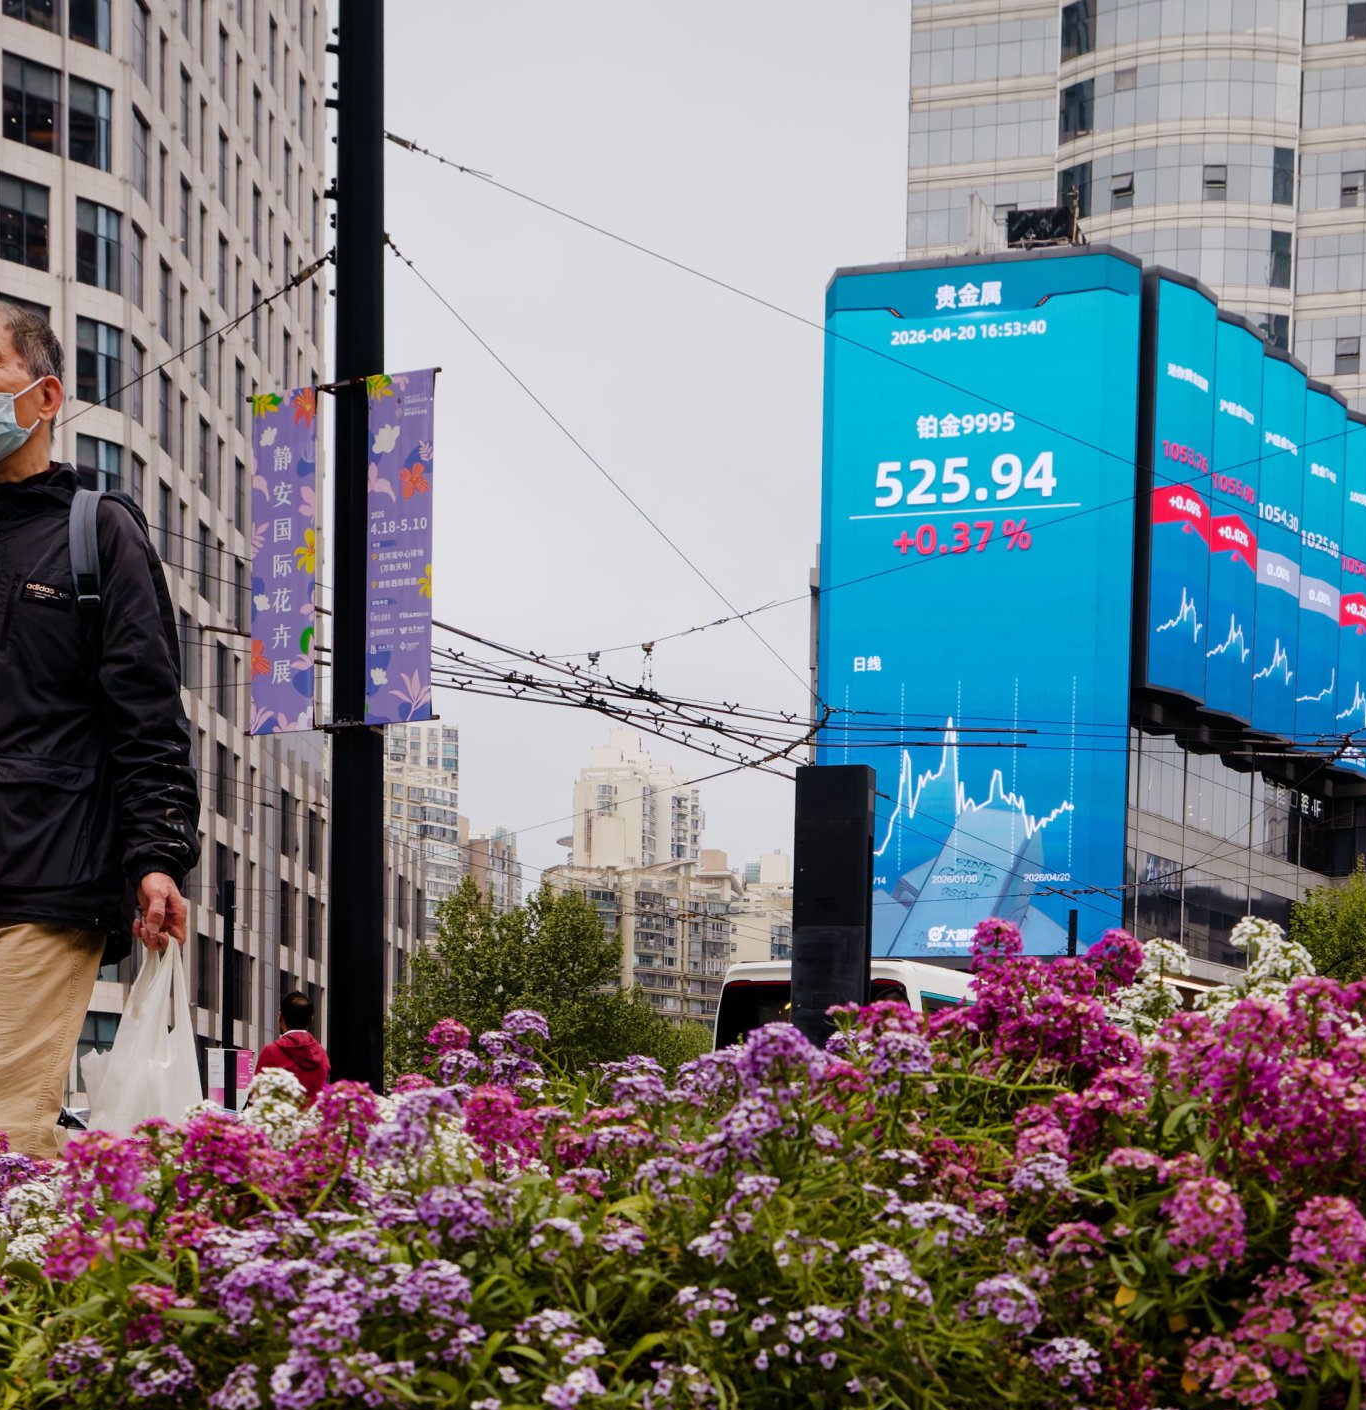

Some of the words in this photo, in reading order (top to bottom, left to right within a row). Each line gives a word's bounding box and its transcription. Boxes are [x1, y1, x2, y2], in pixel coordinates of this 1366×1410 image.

[935, 281, 1002, 310] 贵金属
[890, 325, 977, 345] 2026-04-20
[980, 320, 1047, 338] 16:53:40
[916, 411, 1016, 440] 铂金9995
[874, 451, 1057, 508] 525.94
[370, 517, 428, 535] 4.18-5.10
[1258, 502, 1299, 533] 1054.30
[272, 446, 293, 685] 静安国际花卉展
[26, 583, 55, 595] adidas
[853, 655, 882, 673] 日线
[931, 875, 978, 885] 2026/01/30
[1023, 872, 1071, 883] 2026/04/20
